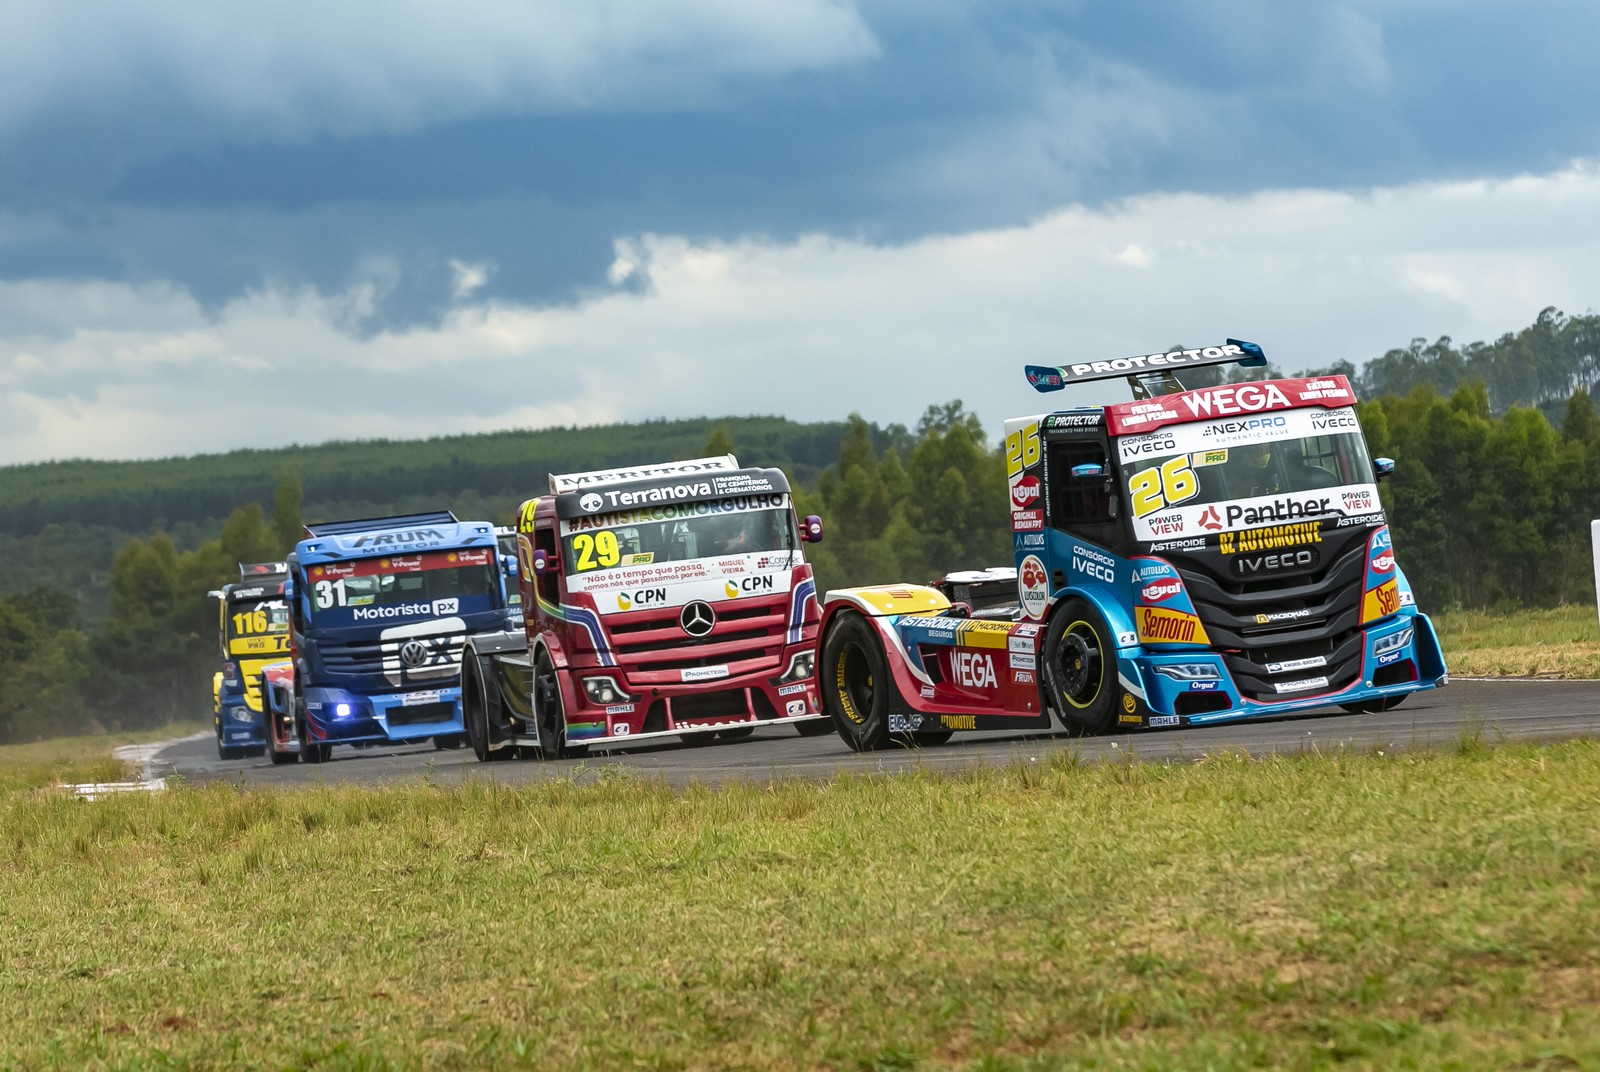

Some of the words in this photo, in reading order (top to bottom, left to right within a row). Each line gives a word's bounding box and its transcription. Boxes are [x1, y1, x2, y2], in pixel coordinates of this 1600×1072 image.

[1070, 344, 1245, 376] PROTECTOR
[1181, 384, 1292, 418] WEGA
[1055, 415, 1101, 427] PROTECTOR
[1213, 417, 1286, 436] NEXPRO
[1312, 418, 1356, 430] IVECO
[1121, 432, 1174, 447] CONSÓRCIO
[1216, 433, 1261, 443] AUTHENTIC
[1266, 429, 1289, 437] VALUE
[1005, 421, 1042, 479] 26
[1123, 440, 1176, 457] IVECO
[1205, 453, 1226, 464] PRO
[560, 461, 726, 487] MERITOR
[715, 474, 751, 483] FRANQUIA
[717, 482, 727, 490] DE
[727, 477, 768, 488] CEMITÉRIOS
[724, 484, 773, 495] CREMATÓRIOS
[1128, 453, 1201, 520] 26
[605, 481, 711, 507] Terranova
[1341, 491, 1371, 501] POWER
[1227, 498, 1330, 527] Panther
[1343, 499, 1372, 511] VIEW
[1148, 514, 1183, 526] POWER
[1151, 522, 1184, 536] VIEW
[1238, 522, 1324, 551] AUTOMOTIVE
[352, 529, 446, 548] FRUM
[1150, 538, 1206, 553] ASTEROIDE
[362, 541, 440, 554] METEOR
[573, 530, 620, 572] 29
[718, 559, 745, 567] MIGUEL
[1073, 545, 1115, 568] CONSÓRCIO
[1238, 550, 1312, 573] IVECO
[622, 569, 653, 579] tempo
[654, 567, 673, 576] que
[674, 563, 705, 573] passa,
[1072, 556, 1115, 584] IVECO
[583, 583, 609, 591] somos
[640, 574, 679, 585] passamos
[742, 575, 773, 591] CPN
[315, 578, 346, 609] 31
[634, 588, 666, 605] CPN
[353, 603, 431, 620] Motorista
[437, 602, 455, 615] px
[232, 610, 268, 635] 116
[897, 616, 960, 631] ASTEROIDE
[1141, 608, 1197, 642] Semorin
[928, 630, 954, 639] SEGUROS
[1379, 652, 1400, 665] Orgus
[684, 669, 727, 679] PROMETEON
[950, 648, 998, 689] WEGA
[779, 685, 805, 695] MAHLE
[1191, 682, 1216, 691] Orgus
[607, 705, 633, 714] MAHLE
[1150, 716, 1179, 726] MAHLE
